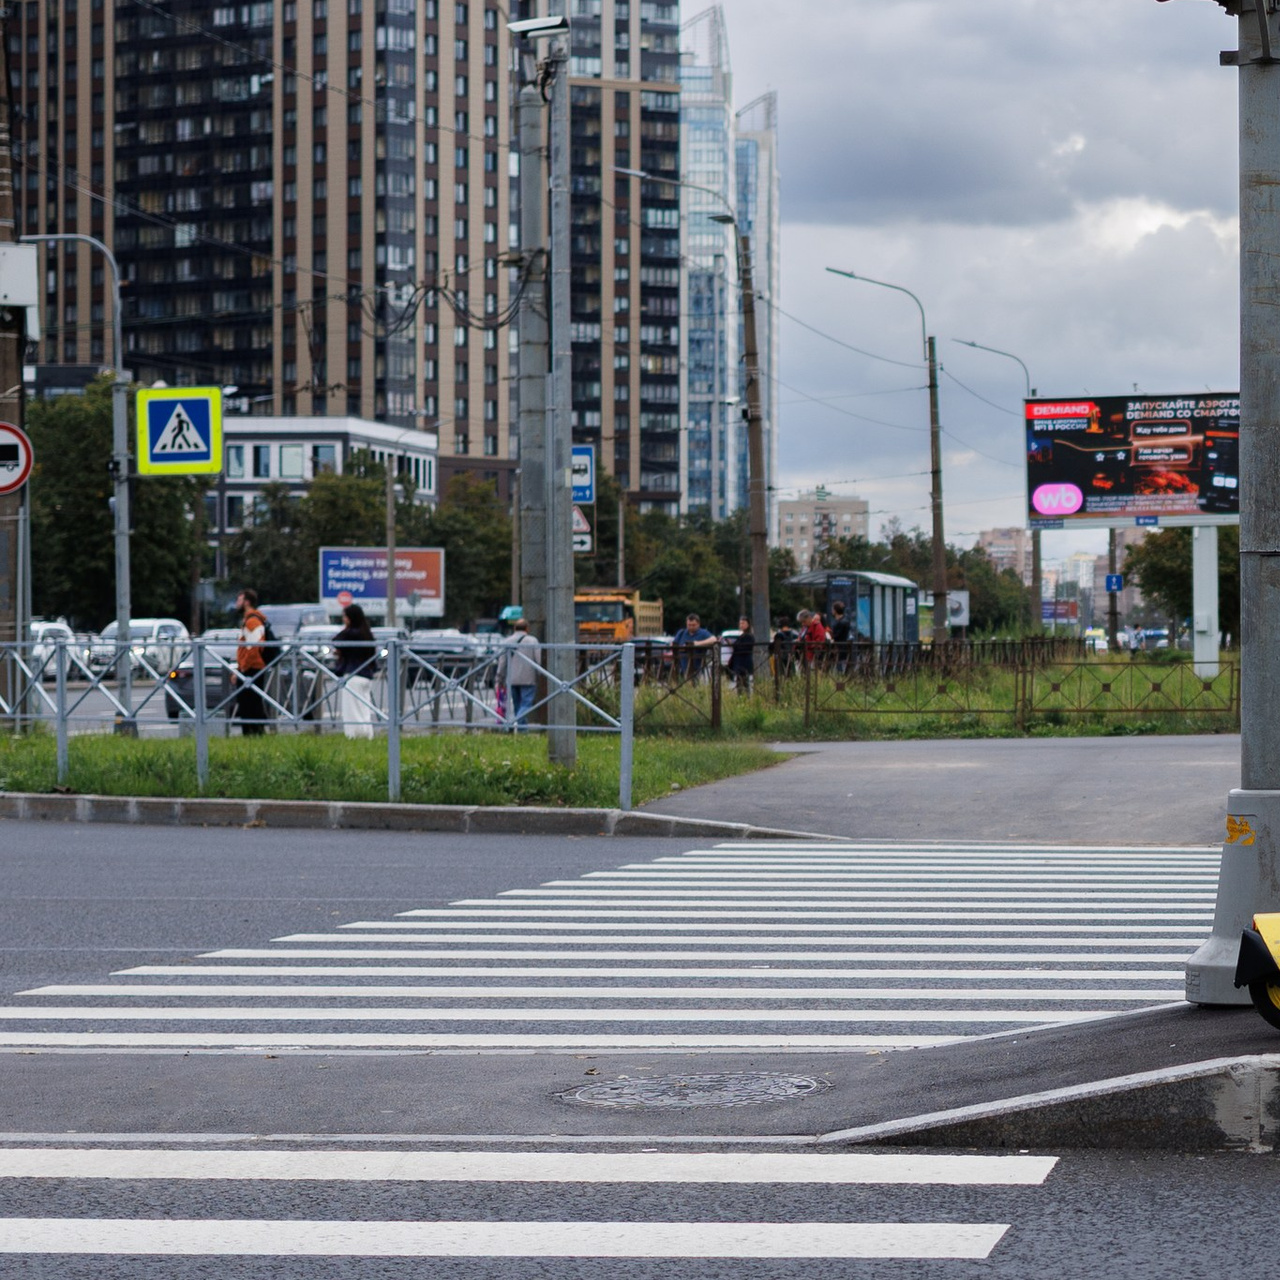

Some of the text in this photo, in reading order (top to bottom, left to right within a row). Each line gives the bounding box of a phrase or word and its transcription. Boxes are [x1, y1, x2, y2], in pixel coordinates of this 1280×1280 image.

[1128, 399, 1240, 410] ЗАПУСКАЙТЕ АЭРОГР
[1033, 405, 1089, 415] DEMIAND
[1126, 410, 1174, 419] DEMIAND
[1176, 410, 1191, 418] СО
[1055, 423, 1088, 431] РОССИИ
[1038, 487, 1078, 509] wb
